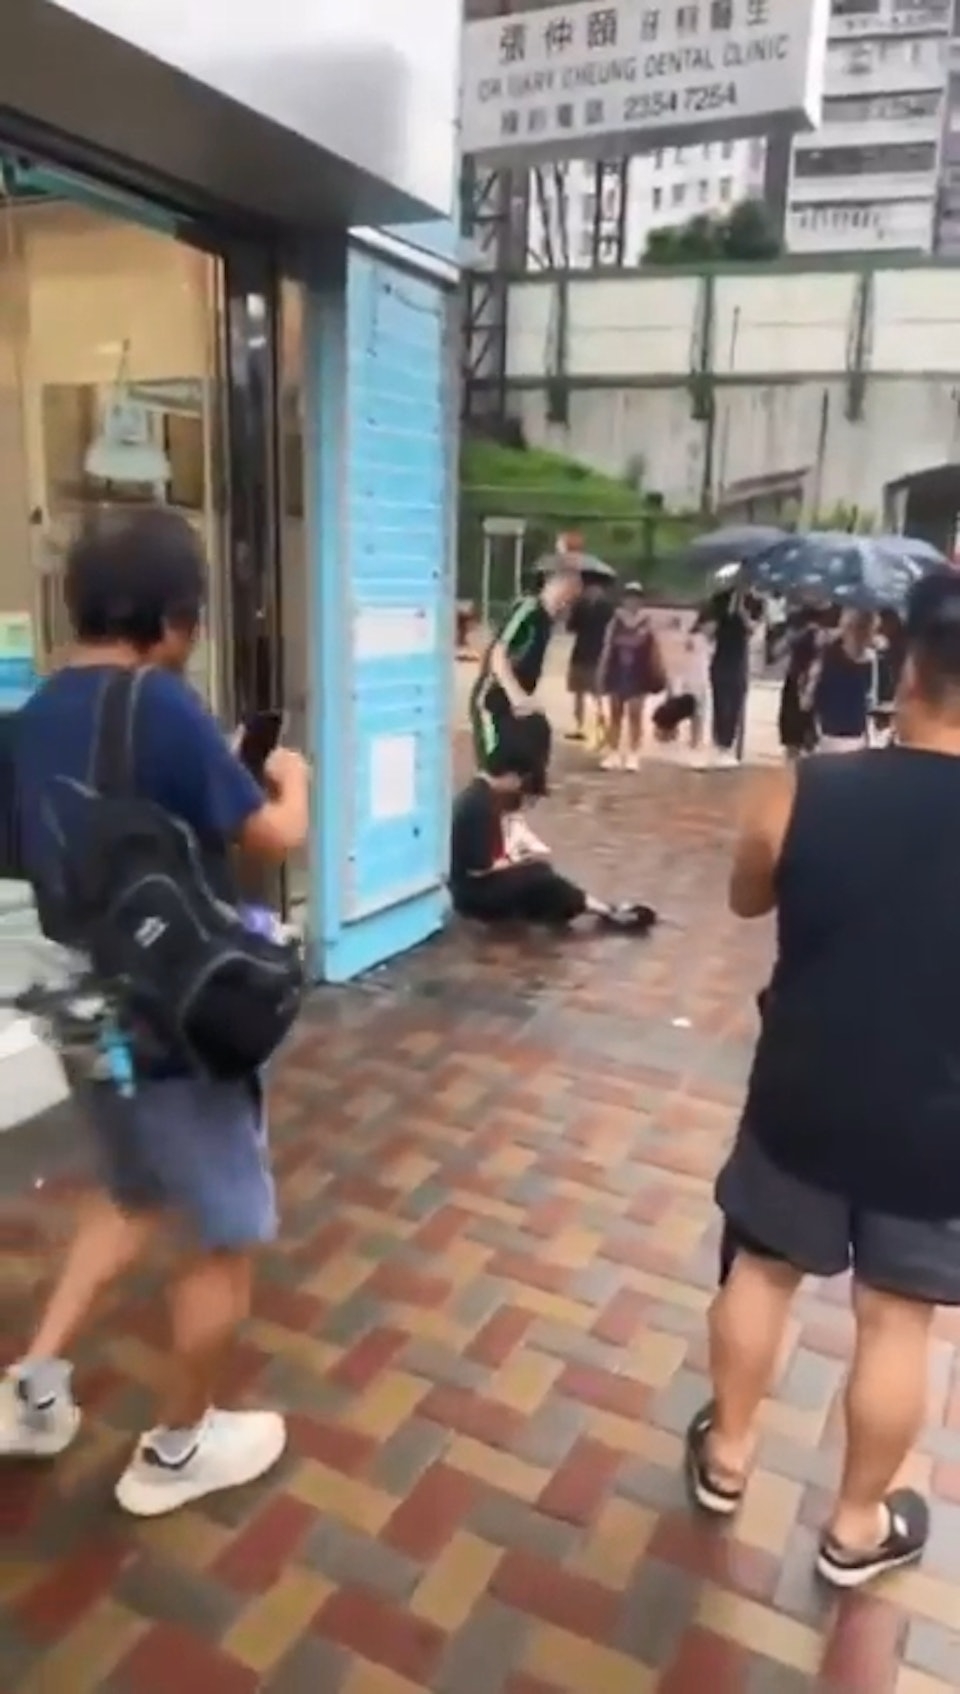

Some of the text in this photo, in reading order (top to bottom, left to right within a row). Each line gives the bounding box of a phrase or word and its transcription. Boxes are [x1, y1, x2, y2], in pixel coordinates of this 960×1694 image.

[561, 56, 636, 90] CHEUNG
[645, 49, 714, 78] DENTAL
[723, 33, 789, 67] CLINIC
